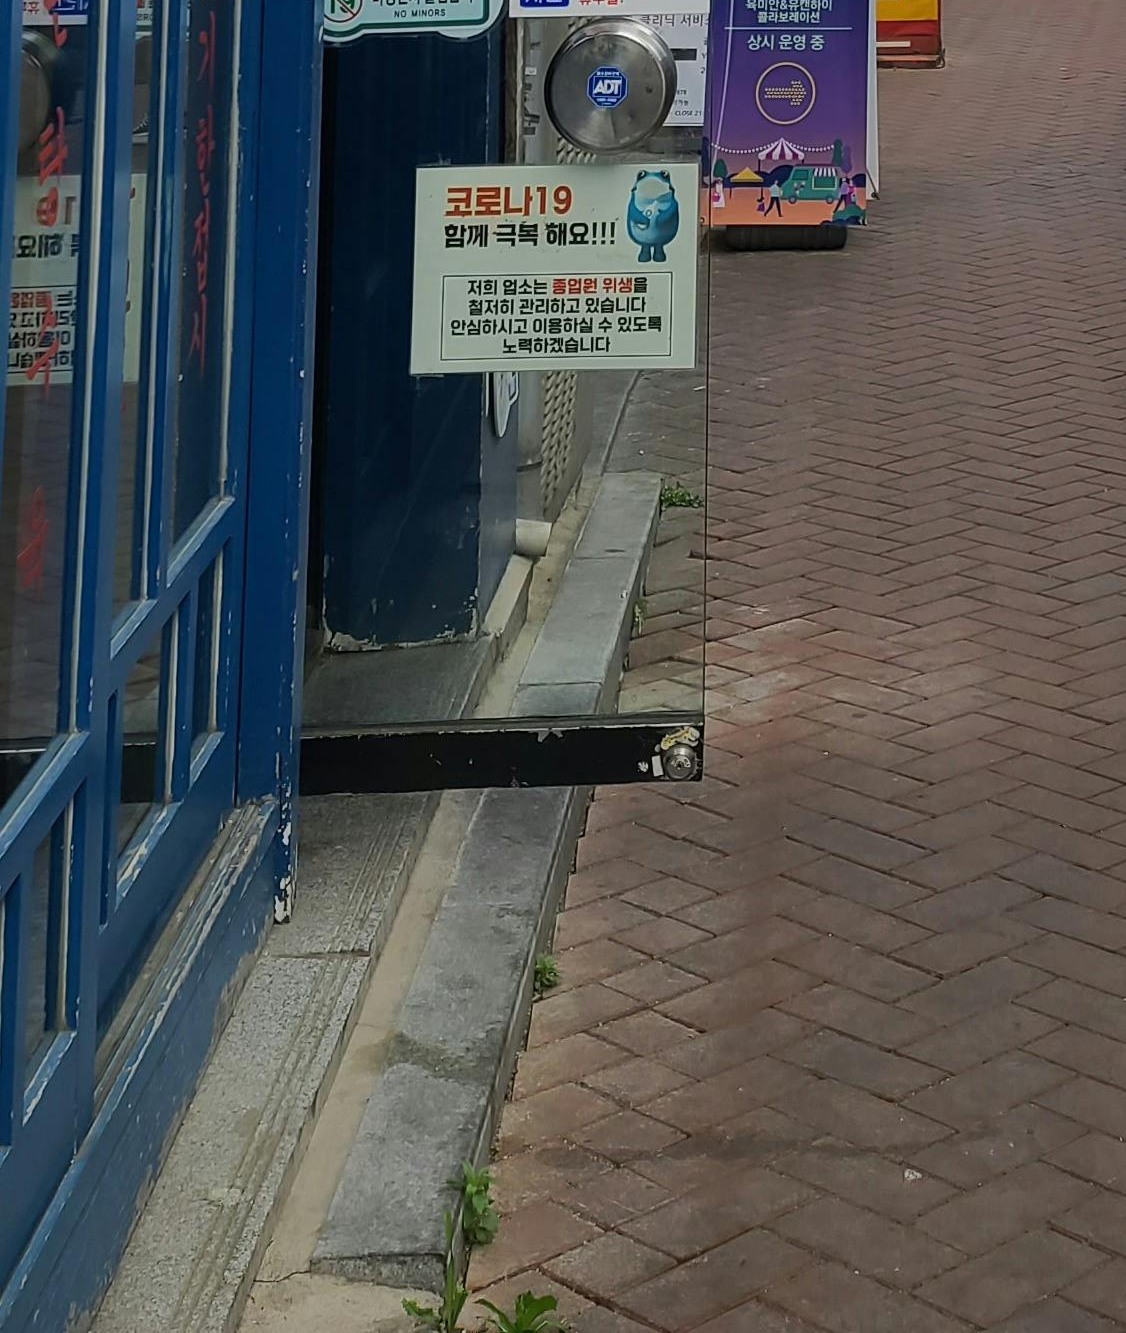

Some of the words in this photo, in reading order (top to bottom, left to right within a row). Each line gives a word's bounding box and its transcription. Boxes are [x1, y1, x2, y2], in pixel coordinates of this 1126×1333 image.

[394, 10, 407, 18] NO
[411, 8, 446, 17] MINORS
[757, 11, 820, 24] 콜라보레이션
[747, 34, 775, 51] 상시
[778, 34, 806, 51] 운영
[810, 34, 825, 51] 중
[593, 79, 622, 95] ADT
[444, 185, 573, 217] 코로나19
[444, 222, 489, 249] 함께
[496, 222, 539, 247] 극복
[546, 221, 616, 247] 해요!!!
[467, 280, 498, 296] 저희
[503, 279, 548, 295] 업소는
[552, 278, 598, 294] 종업원
[602, 277, 648, 294] 위생을
[468, 298, 515, 315] 철저히
[519, 298, 580, 315] 관리하고
[585, 296, 646, 314] 있습니다
[450, 318, 528, 336] 안심하시고
[532, 317, 594, 335] 이용하실
[598, 317, 613, 333] 수
[617, 316, 662, 333] 있도록
[502, 337, 611, 354] 노력하겠습니다
